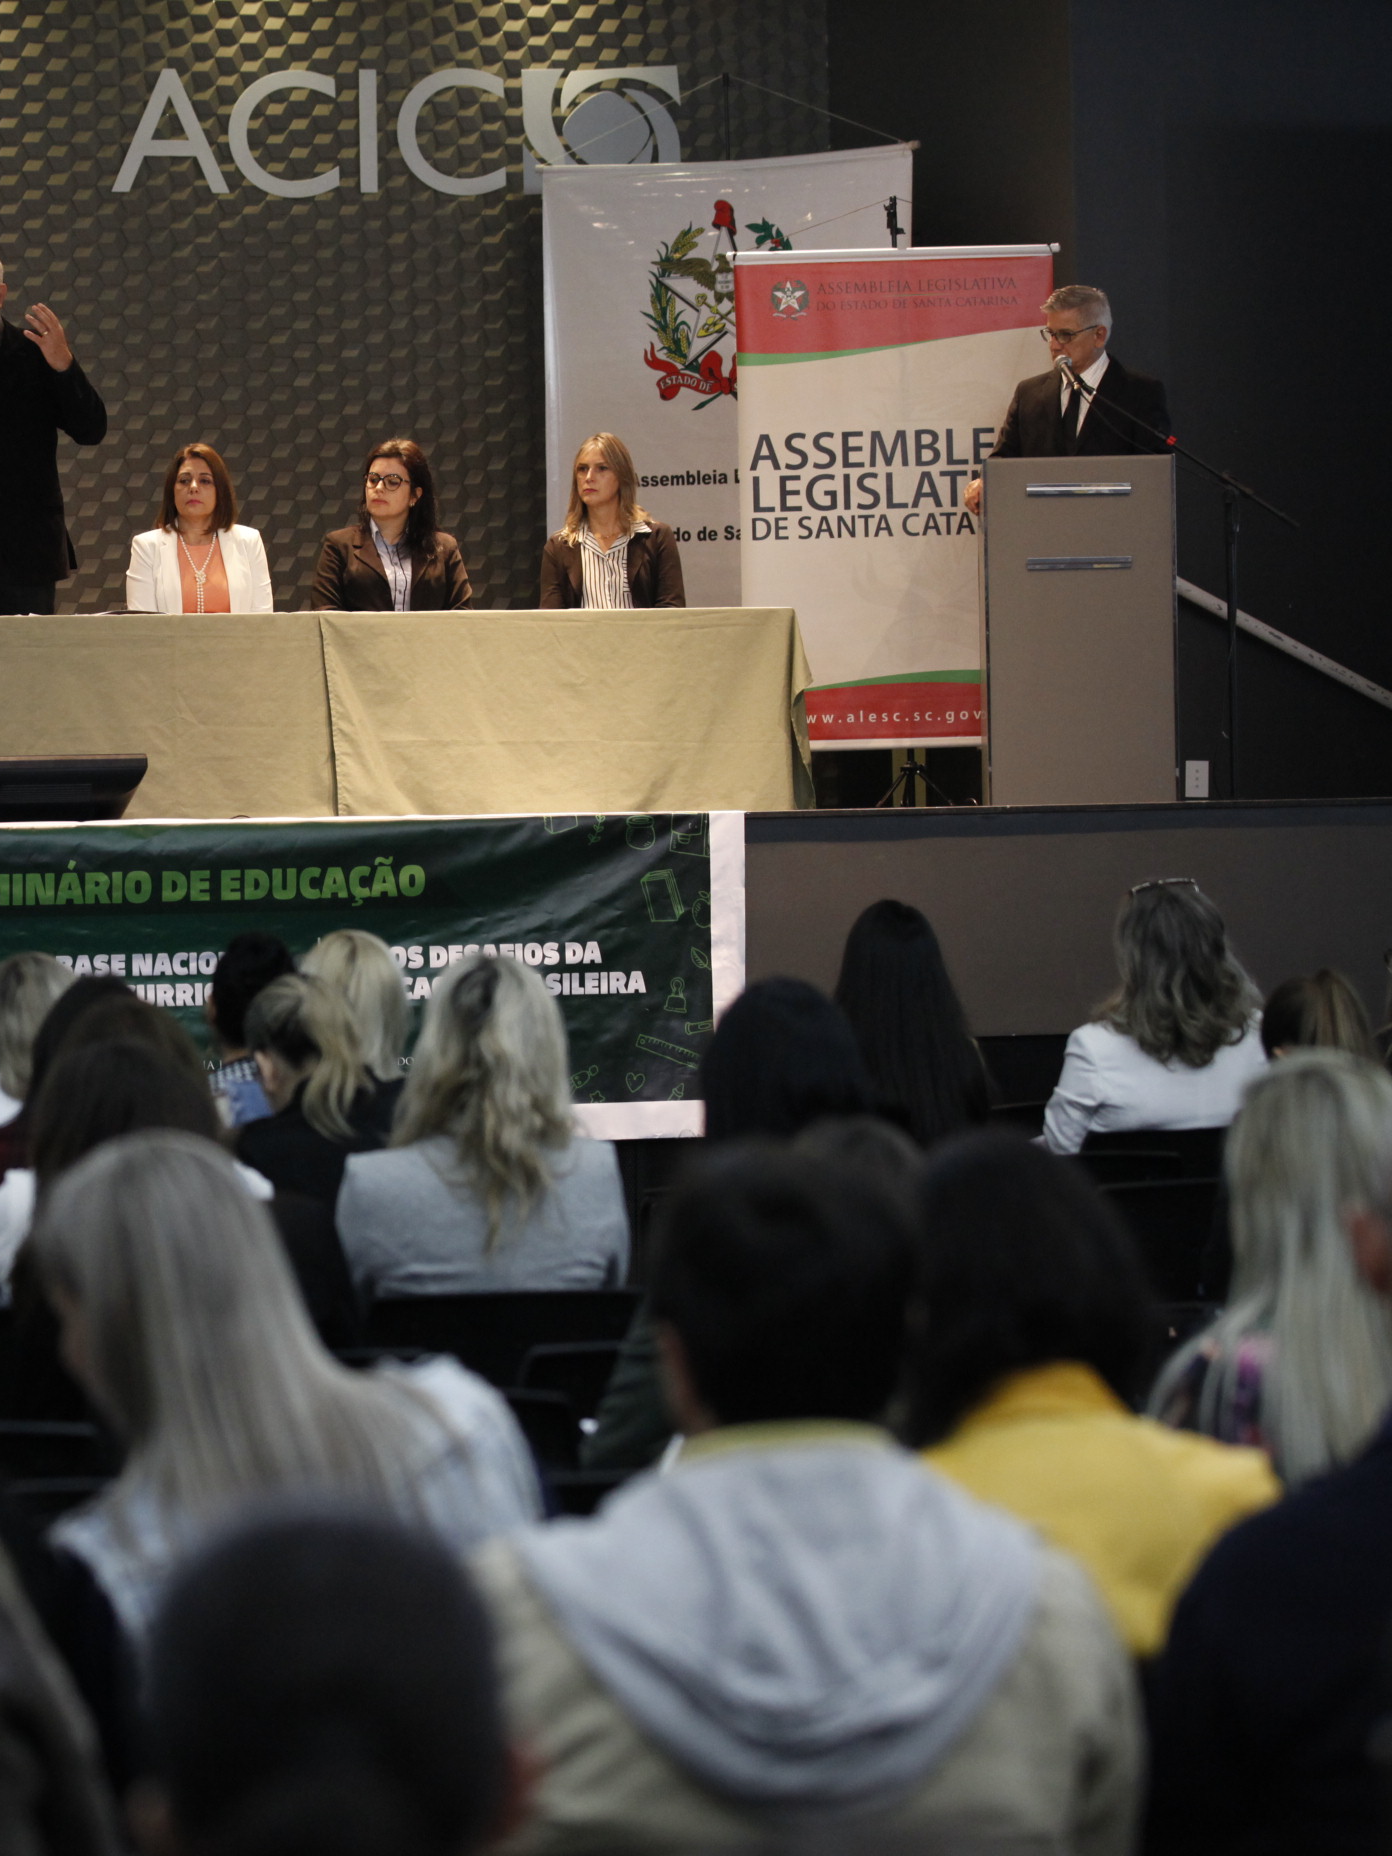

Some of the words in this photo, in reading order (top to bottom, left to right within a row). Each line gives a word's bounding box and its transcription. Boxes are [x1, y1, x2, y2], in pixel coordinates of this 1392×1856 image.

[817, 280, 913, 295] ASSEMBLEIA
[918, 277, 1017, 292] LEGISLATIVA
[816, 300, 836, 312] DO
[840, 300, 888, 311] ESTADO
[893, 299, 908, 310] DE
[912, 297, 952, 309] SANTA
[955, 296, 1018, 308] CATARINA
[660, 375, 697, 390] ESTADO
[699, 381, 713, 393] DE
[749, 427, 995, 471] ASSEMBLE
[637, 469, 728, 488] ssembleia
[752, 469, 980, 513] LEGISLAT
[697, 526, 718, 542] de
[751, 517, 789, 541] DE
[797, 514, 894, 540] SANTA
[901, 511, 976, 537] CATA
[161, 870, 211, 903] DE
[220, 856, 426, 907] EDUCAÇÃO
[131, 951, 228, 977] NACIO
[565, 941, 603, 966] DA
[544, 970, 647, 997] SILEIRA
